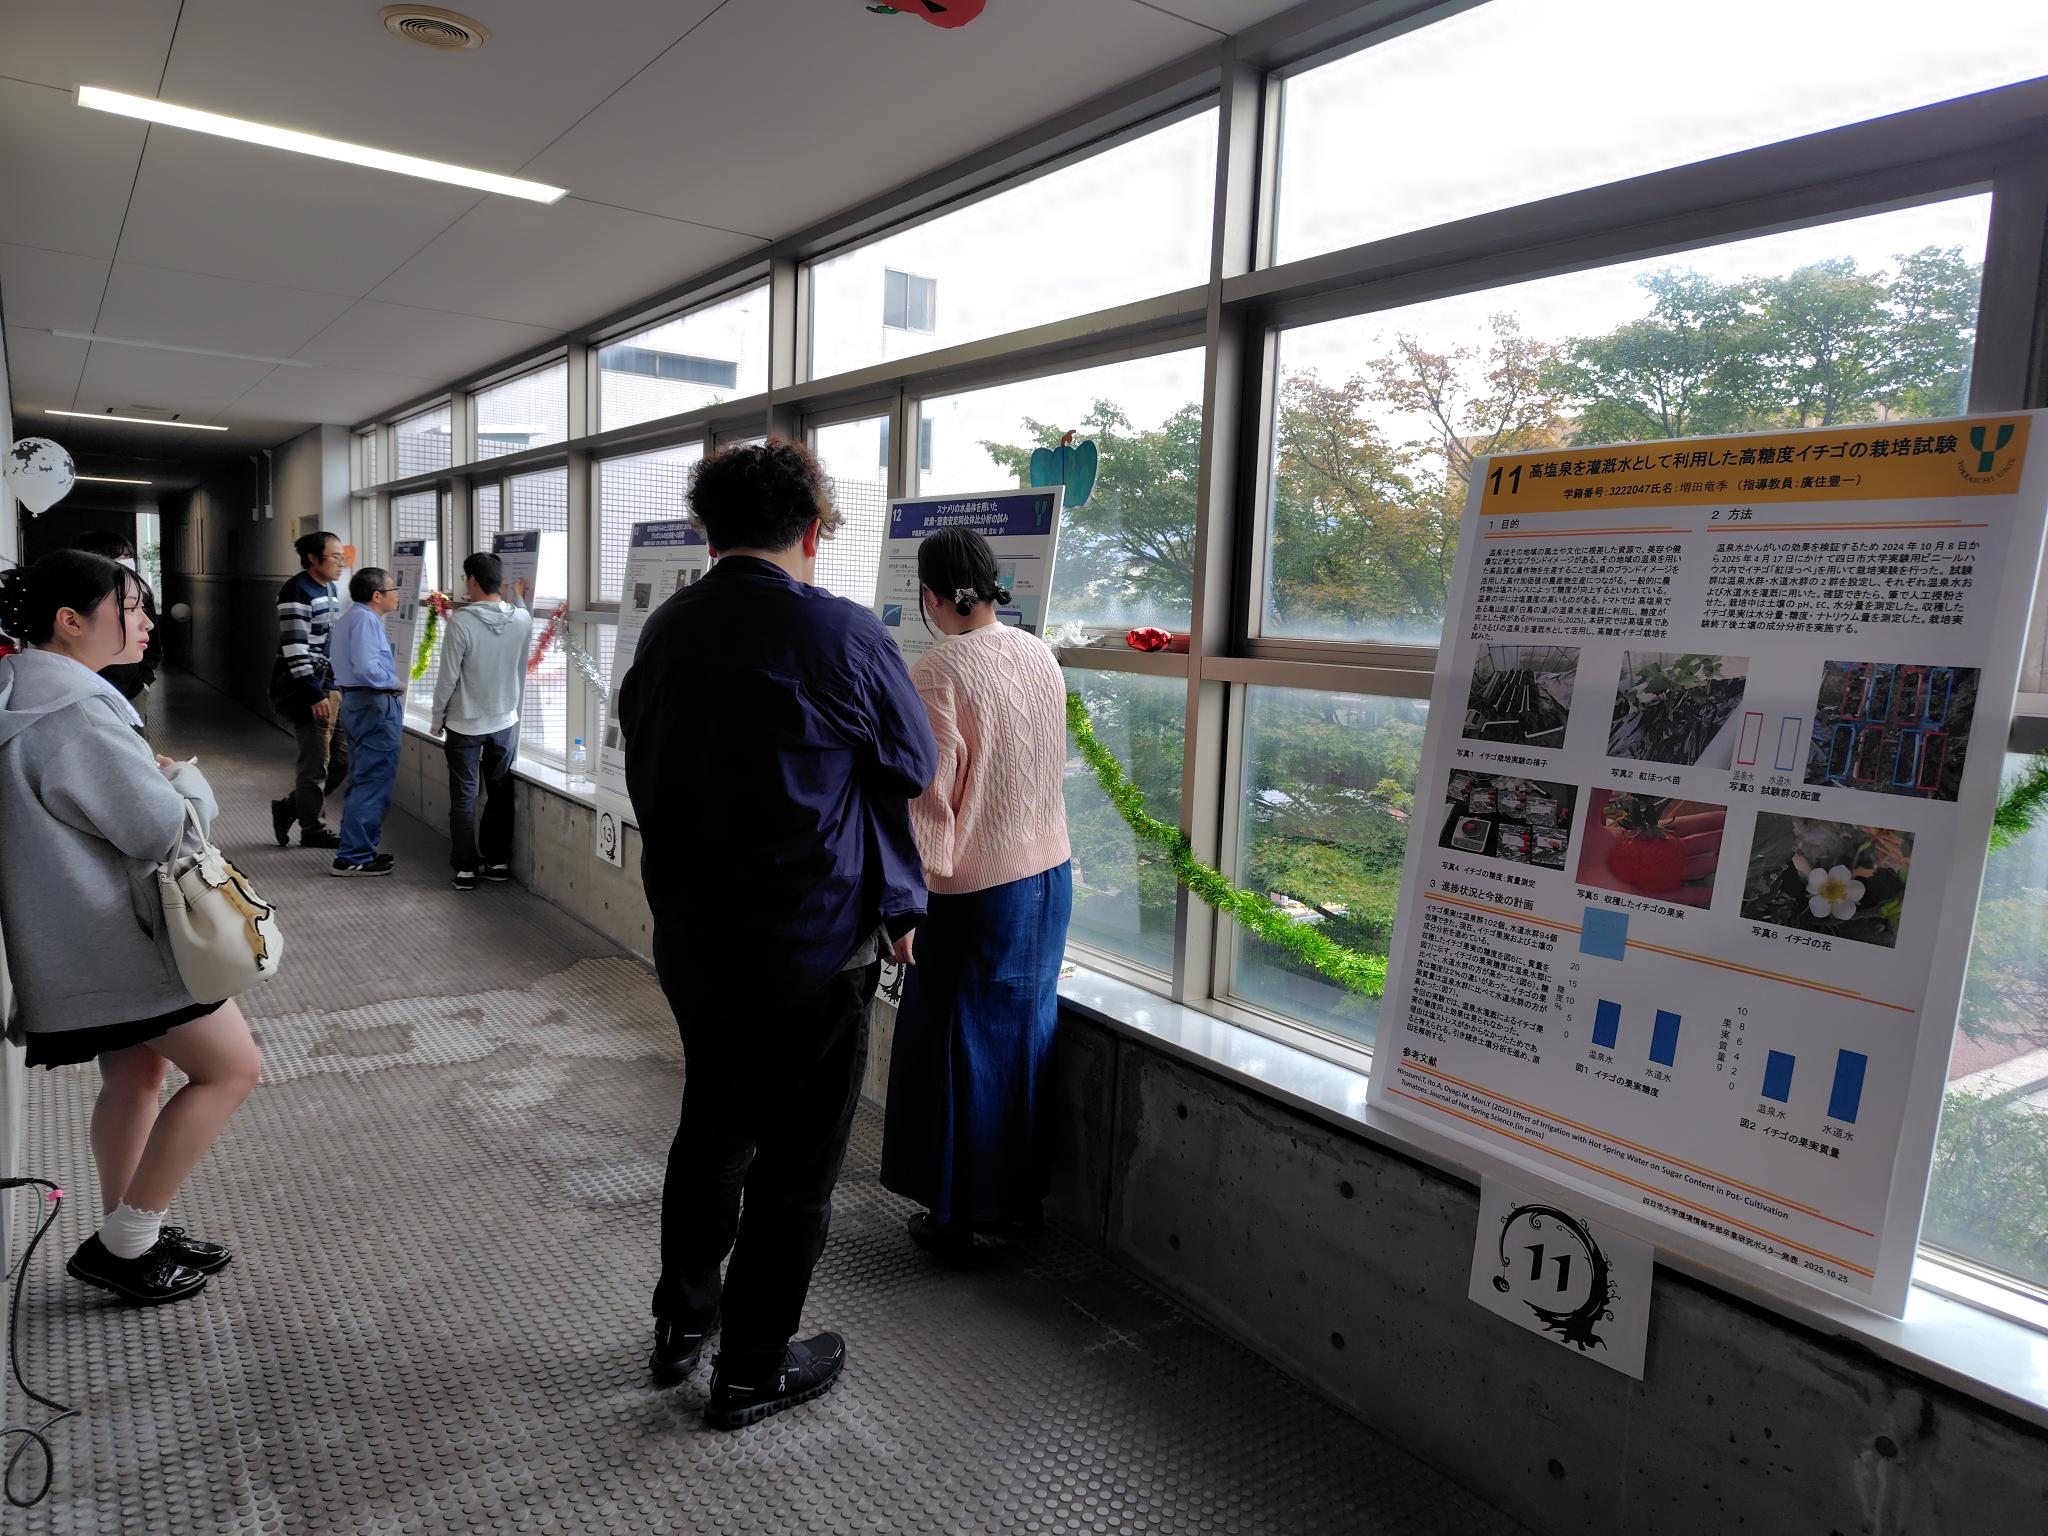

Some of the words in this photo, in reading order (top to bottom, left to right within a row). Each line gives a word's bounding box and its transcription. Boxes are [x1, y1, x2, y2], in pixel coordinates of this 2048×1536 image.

[1529, 434, 1958, 479] 高塩泉を灌漑水として利用した高糖度イチゴの栽培試験
[1489, 463, 1522, 496] 11
[892, 508, 902, 522] 12
[1711, 510, 1720, 521] 2
[1728, 508, 1753, 521] 方法
[1500, 518, 1520, 530] 目的
[1638, 772, 1680, 785] 紅ほっぺ苗
[1728, 781, 1754, 793] 写真3
[1761, 786, 1821, 802] 試験群の配置
[603, 827, 612, 843] 13
[1429, 879, 1436, 888] 3
[1441, 880, 1534, 911] 進捗状況と今後の計画
[1577, 889, 1599, 901] 写真5
[1604, 895, 1685, 920] 収穫したイチゴの果実
[1751, 926, 1777, 939] 写真6
[1785, 934, 1832, 952] イチゴの花
[1570, 963, 1580, 971] 20
[1568, 980, 1577, 988] 15
[1566, 996, 1575, 1005] 10
[1567, 1014, 1572, 1022] 5
[1737, 1007, 1748, 1016] 10
[1739, 1022, 1745, 1031] 8
[1736, 1038, 1742, 1046] 6
[1402, 1046, 1437, 1068] 参考文献
[1588, 1049, 1614, 1064] 温泉水
[1645, 1067, 1672, 1083] 水道水
[1731, 1067, 1738, 1075] 2
[1575, 1062, 1589, 1074] 図1
[1594, 1070, 1660, 1098] イチゴの果実糖度
[1728, 1082, 1735, 1090] 0
[1429, 1090, 1451, 1103] Journal
[1458, 1101, 1470, 1110] Hot
[1471, 1105, 1490, 1119] Spring
[1525, 1125, 1545, 1140] press)
[1756, 1103, 1786, 1120] 温泉水
[1739, 1117, 1756, 1131] 図2
[1763, 1126, 1840, 1160] イチゴの果実質量
[1822, 1124, 1853, 1142] 水道水
[1492, 1103, 1512, 1117] (2025)
[1513, 1110, 1531, 1122] Effect
[1540, 1121, 1570, 1138] Irrigation
[1572, 1133, 1587, 1144] with
[1588, 1139, 1602, 1150] Hot
[1603, 1143, 1625, 1160] Spring
[1626, 1152, 1649, 1167] Water
[1650, 1163, 1660, 1172] on
[1661, 1163, 1683, 1180] Sugar
[1684, 1174, 1714, 1192] Content
[1716, 1184, 1724, 1195] in
[1726, 1188, 1742, 1202] Pot-
[1744, 1197, 1788, 1220] Cultivation
[1524, 1244, 1571, 1292] 11
[1803, 1260, 1849, 1283] 2025.10.25
